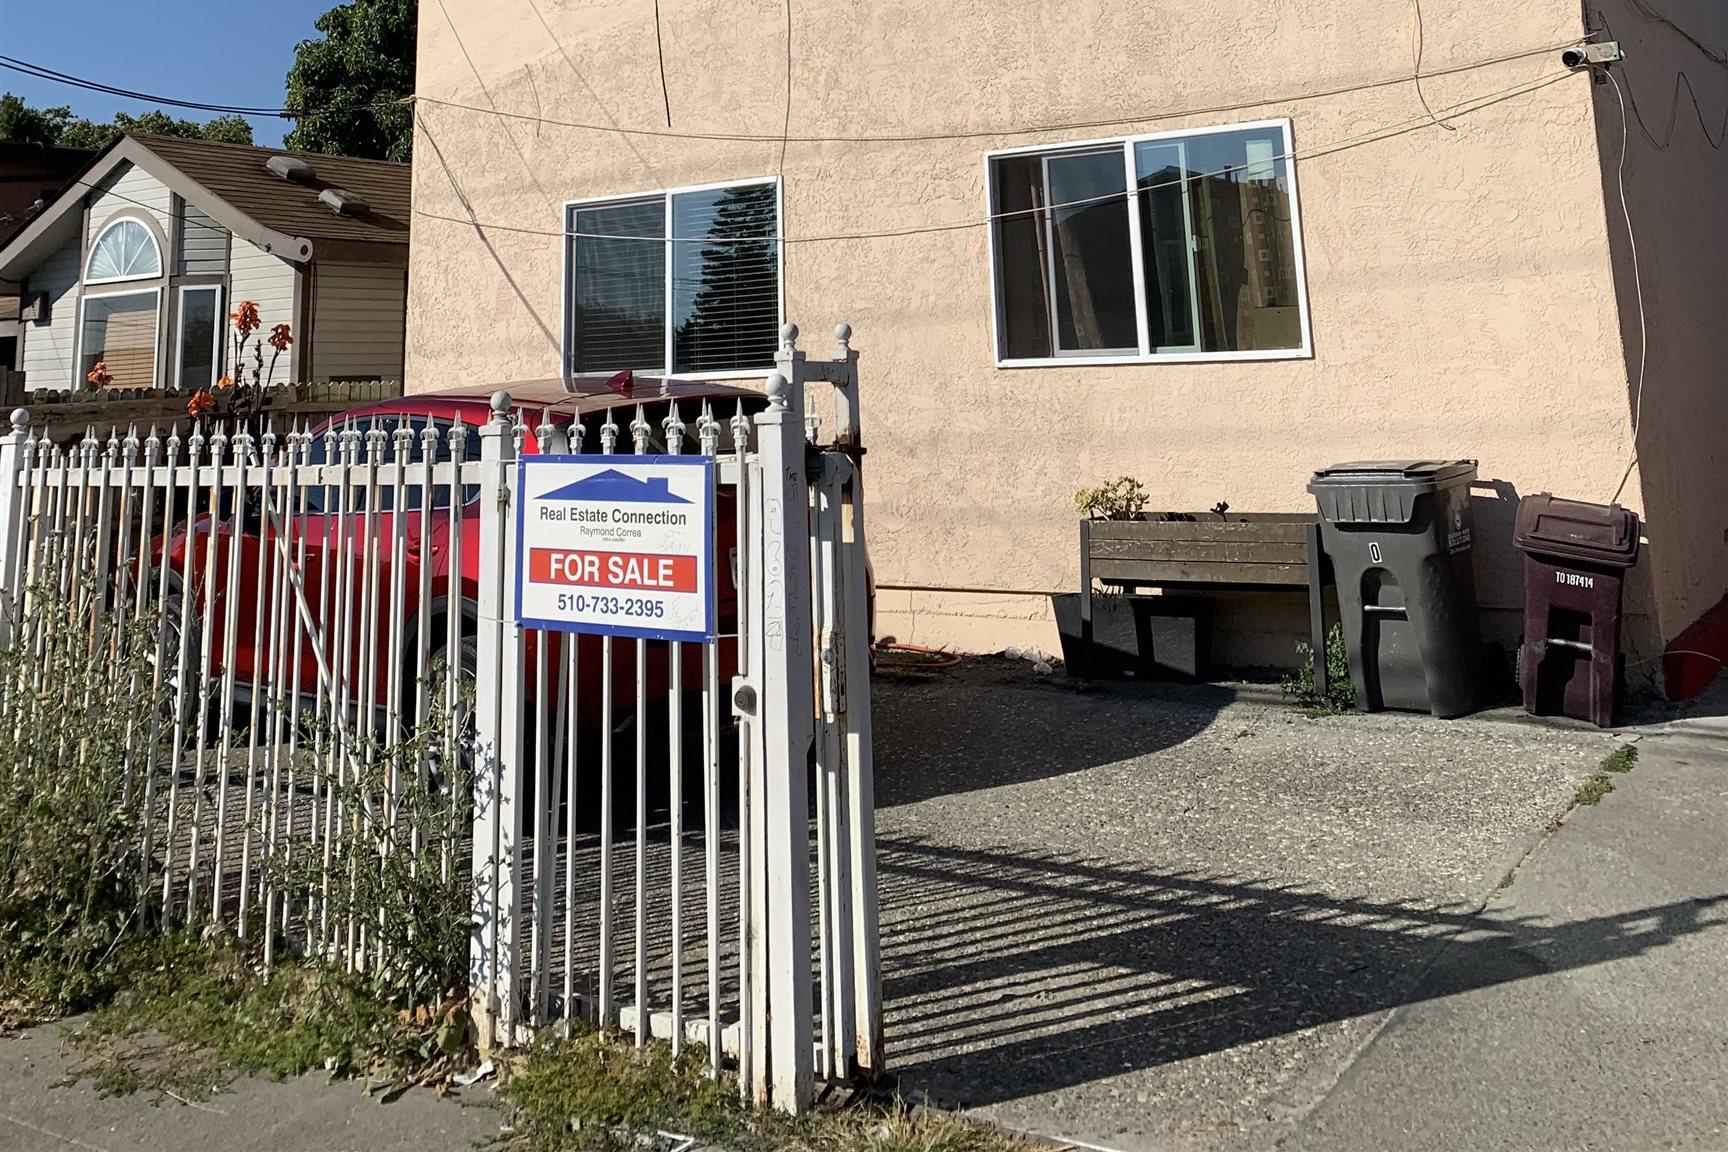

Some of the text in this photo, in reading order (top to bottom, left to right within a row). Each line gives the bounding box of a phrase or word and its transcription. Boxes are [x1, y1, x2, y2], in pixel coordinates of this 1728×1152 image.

[540, 506, 687, 526] Real Estate Connection
[580, 526, 642, 538] Raymond Correa
[550, 553, 675, 587] FOR SALE
[1566, 574, 1594, 589] 187414
[557, 594, 664, 618] 510-733-2395
